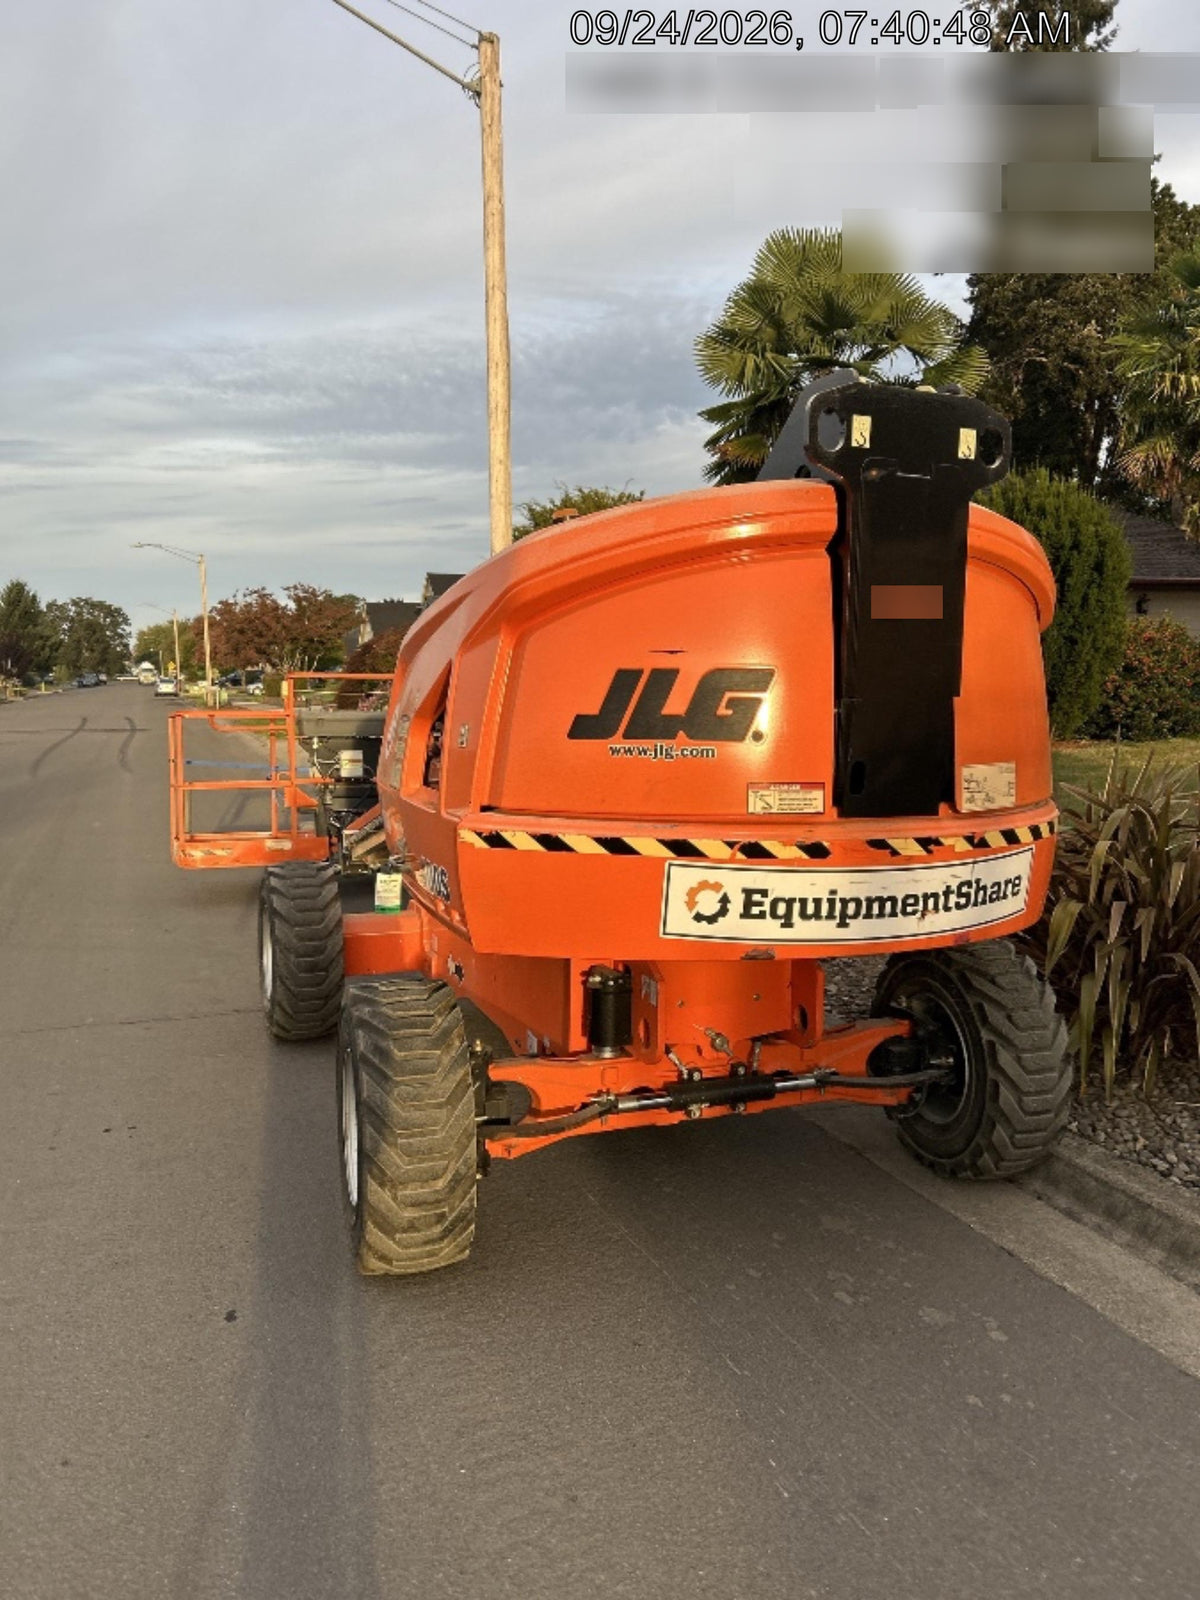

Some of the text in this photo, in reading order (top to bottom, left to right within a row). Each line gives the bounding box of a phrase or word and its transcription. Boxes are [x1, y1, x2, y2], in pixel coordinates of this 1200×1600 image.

[567, 668, 776, 742] JLG
[609, 744, 716, 760] www.jlg.com
[739, 873, 1022, 929] EquipmentShare
